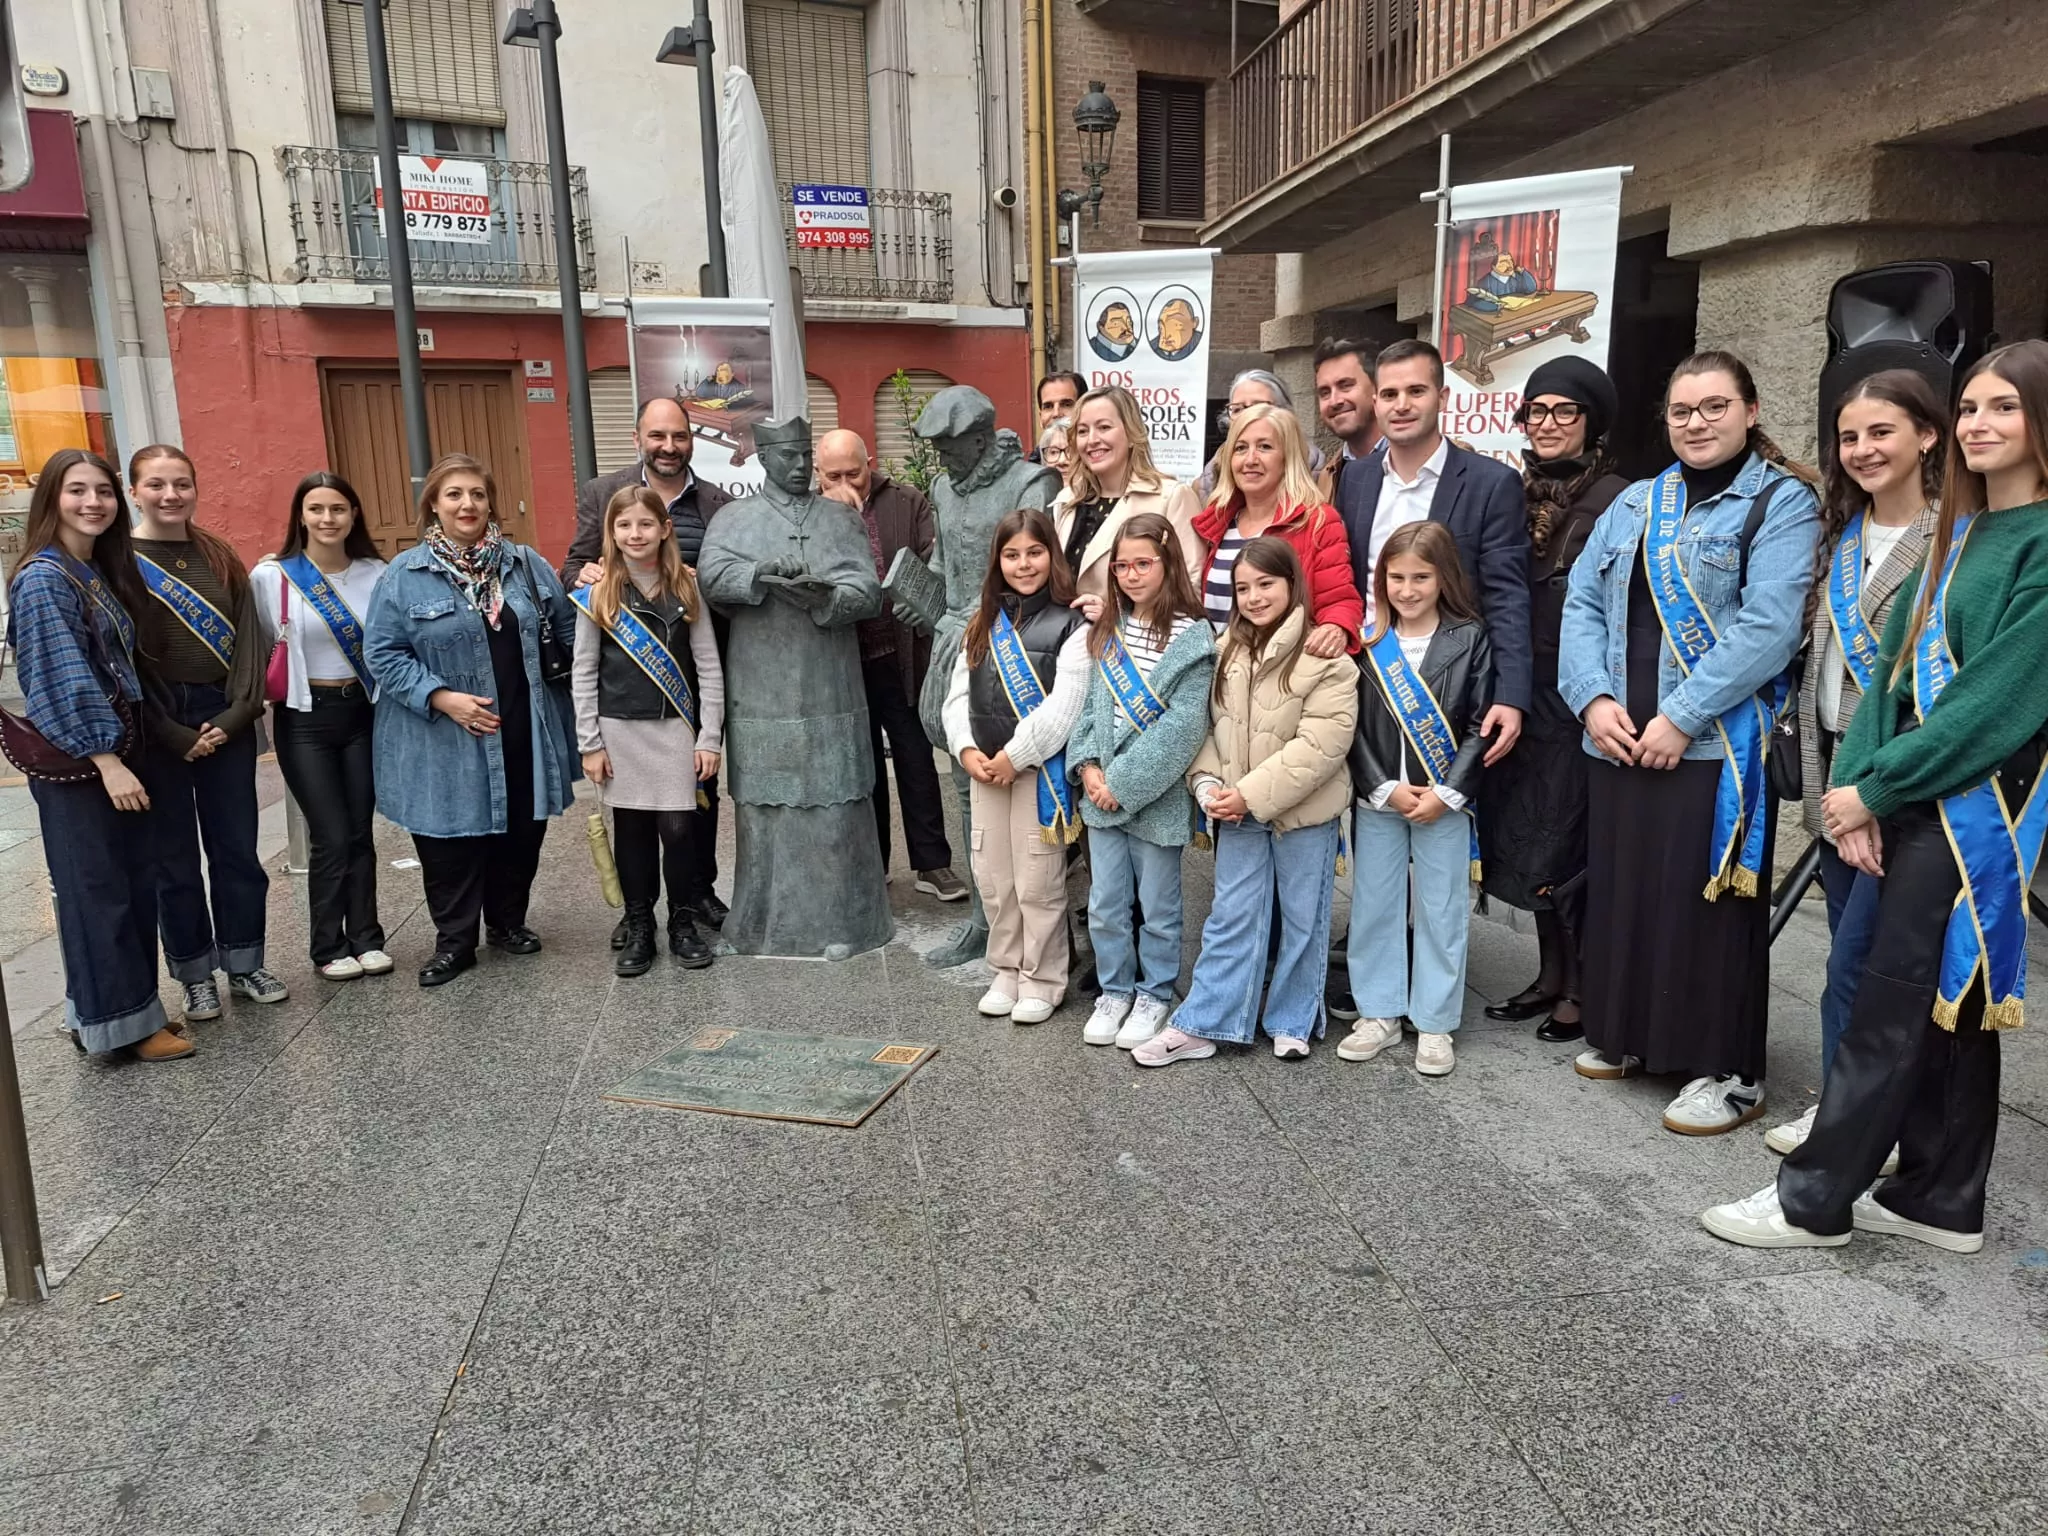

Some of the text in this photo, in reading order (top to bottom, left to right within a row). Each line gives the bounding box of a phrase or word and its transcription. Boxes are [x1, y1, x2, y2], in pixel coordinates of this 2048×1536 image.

[409, 173, 473, 186] MIKI HOME
[402, 192, 485, 213] NTA EDIFICIO
[797, 190, 863, 203] SE VENDE
[422, 214, 453, 230] 779
[457, 216, 487, 232] 873
[813, 211, 865, 221] PRADOSOL
[798, 232, 869, 244] 974 308 995
[1092, 370, 1134, 388] DOS
[1131, 388, 1185, 407] EROS,
[1443, 392, 1525, 414] LUPER
[1441, 413, 1525, 435] LEONA
[1660, 471, 1684, 514] Dama
[1658, 519, 1683, 537] de
[161, 578, 219, 636] Dama de
[311, 581, 345, 624] Dama
[342, 621, 357, 641] de
[1675, 615, 1711, 662] 202
[1386, 656, 1421, 714] Dama
[1410, 713, 1451, 779] Infan
